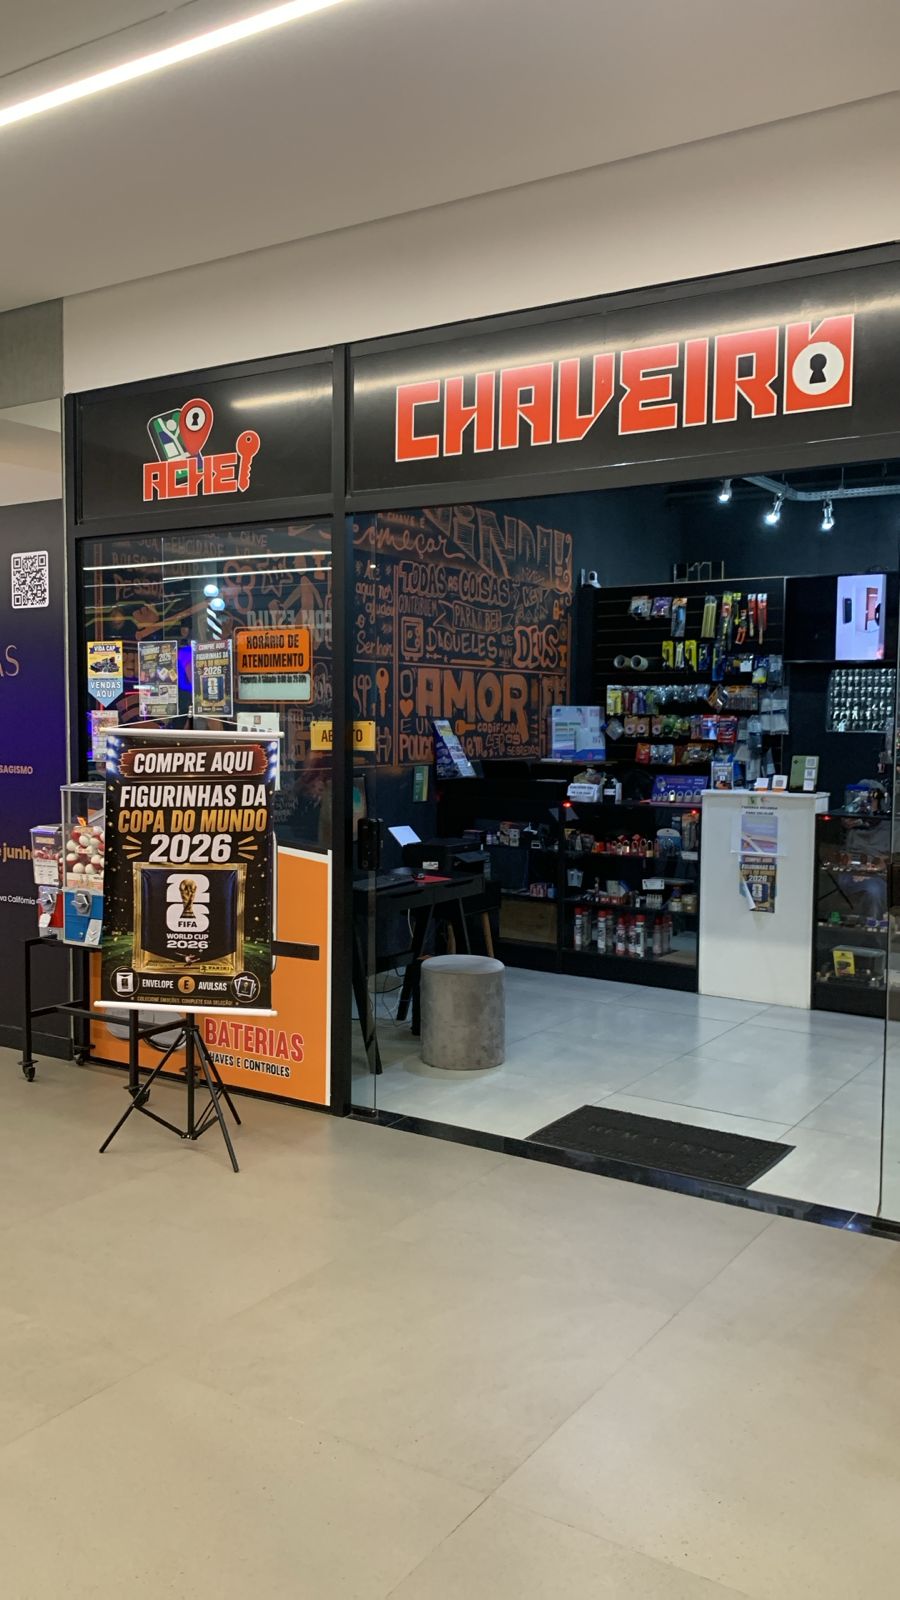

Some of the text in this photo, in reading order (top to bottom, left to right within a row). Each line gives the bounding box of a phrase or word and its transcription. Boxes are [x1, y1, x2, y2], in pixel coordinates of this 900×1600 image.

[395, 314, 855, 462] CHAVEIRO
[246, 632, 285, 649] HORÁRIO
[287, 634, 299, 648] DE
[0, 645, 19, 677] S
[241, 653, 304, 668] ATENDIMENTO
[91, 681, 121, 689] VENDAS
[97, 690, 115, 698] AQUI
[415, 667, 529, 744] AMOR
[321, 729, 364, 742] ABO
[133, 751, 254, 775] COMPRE AQUI
[119, 785, 237, 808] FIGURINHAS
[240, 784, 267, 807] DA
[117, 808, 267, 833] COPA DO MUNDO
[3, 843, 33, 862] junh
[148, 833, 232, 863] 2026
[178, 920, 198, 928] FIFA
[166, 941, 209, 949] 2026
[142, 979, 227, 992] ENVELOPE E AVULSAS
[204, 1017, 305, 1063] BATERIAS
[207, 1052, 291, 1078] HAVES E CONTROLES
